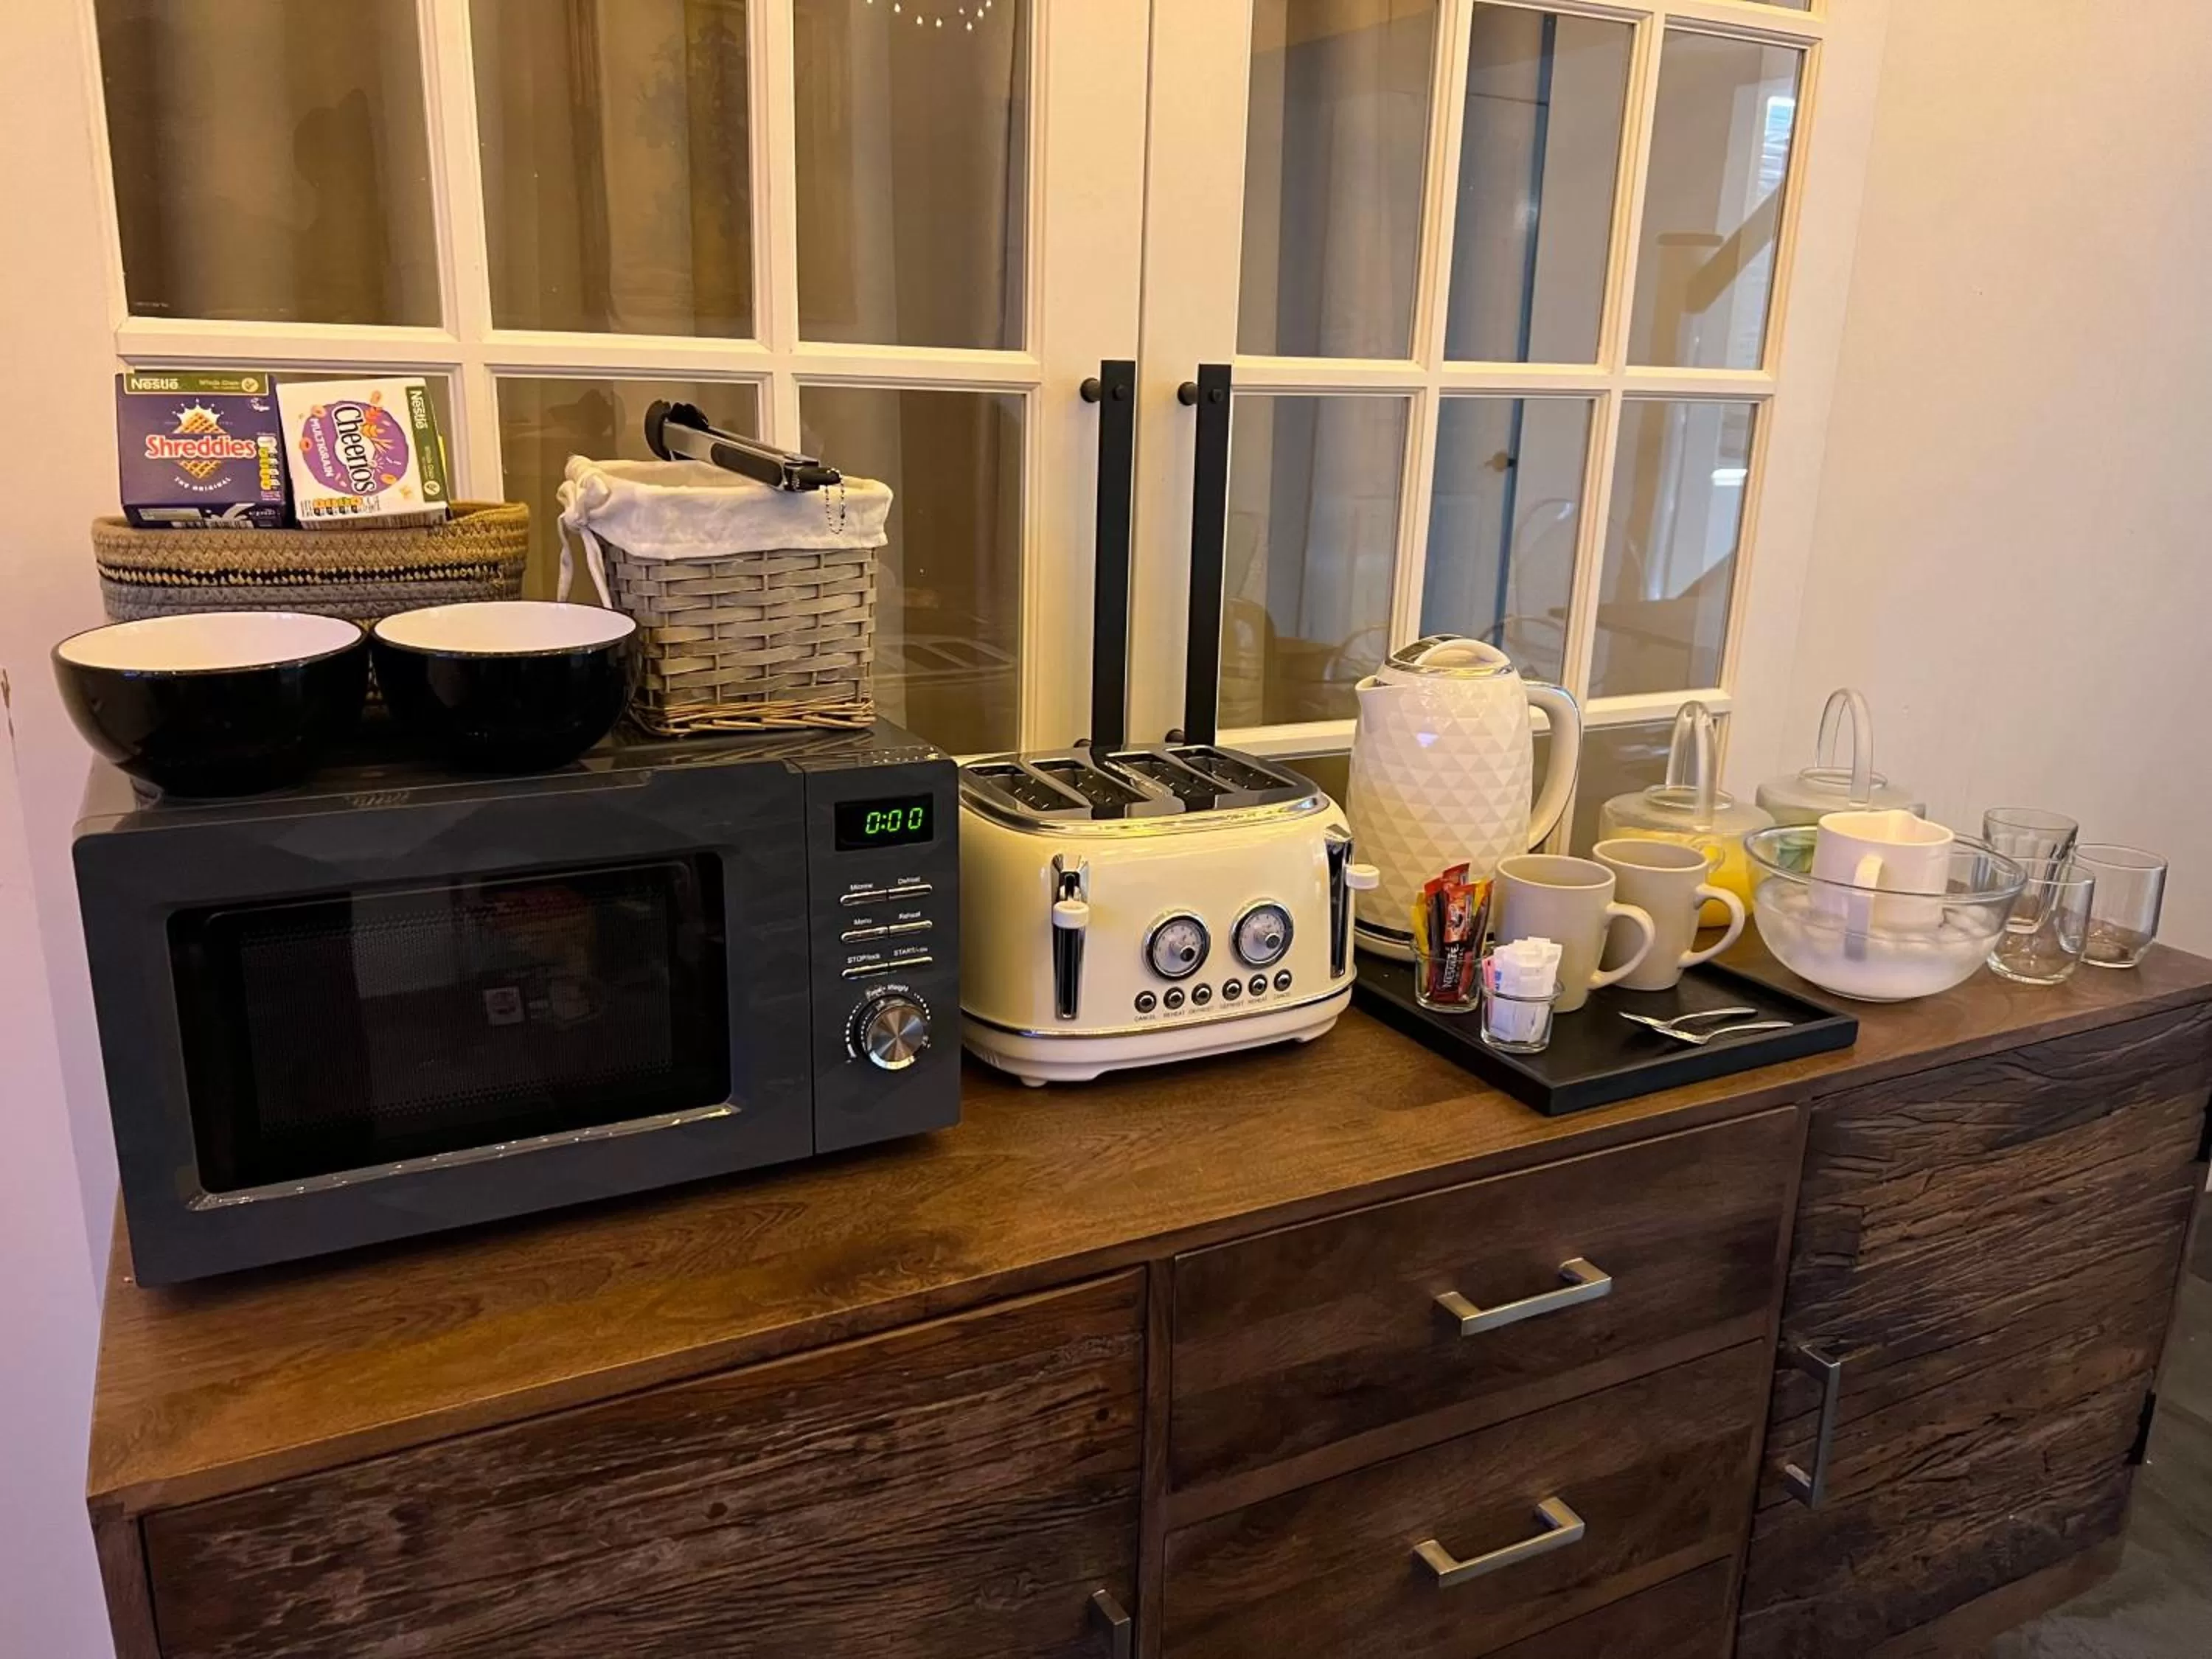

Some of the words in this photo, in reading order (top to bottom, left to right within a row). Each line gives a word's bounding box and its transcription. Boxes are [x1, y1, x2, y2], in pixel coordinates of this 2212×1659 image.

[146, 436, 256, 458] Shreddies
[310, 418, 333, 478] MULTIGRAIN
[333, 406, 375, 493] Cheerios
